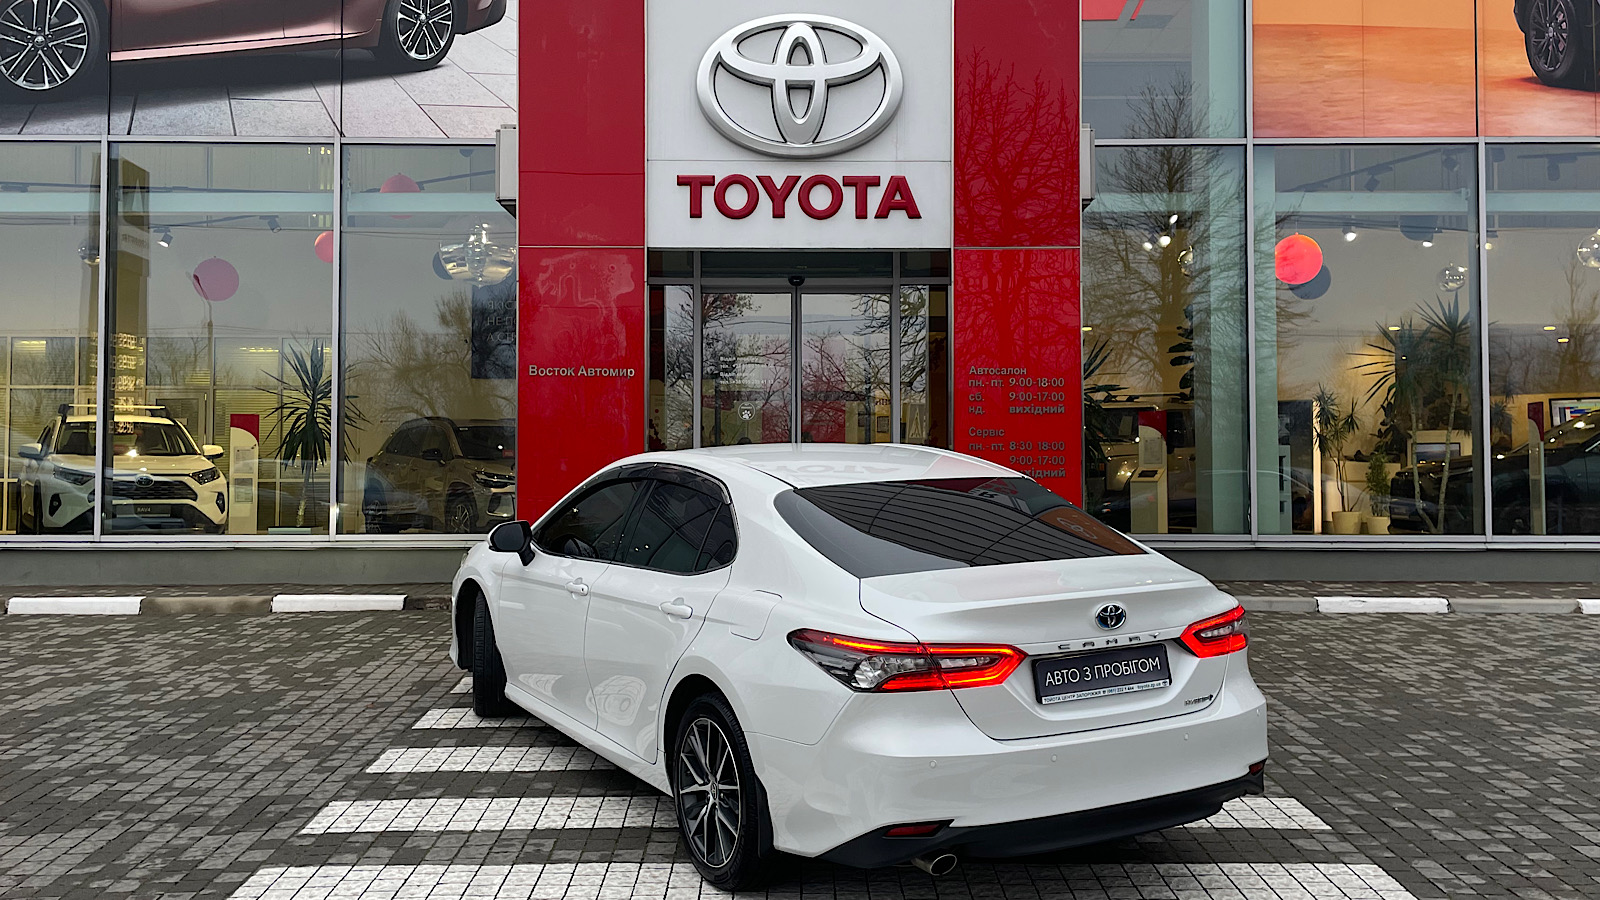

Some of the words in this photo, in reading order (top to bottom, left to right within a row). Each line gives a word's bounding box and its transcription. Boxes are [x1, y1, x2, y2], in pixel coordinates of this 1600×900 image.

[677, 173, 922, 220] TOYOTA
[529, 364, 575, 377] Восток
[577, 365, 635, 379] Автомир
[969, 365, 1027, 375] Автосалон
[968, 392, 985, 401] сб.
[1009, 391, 1065, 401] 9:00-17:00
[968, 405, 986, 415] нд.
[1009, 404, 1065, 416] вихідний
[968, 427, 1005, 438] Сервіс
[1009, 455, 1066, 465] 9:00-17:00
[1058, 632, 1161, 650] CAMRY
[1045, 668, 1080, 687] АВТО
[1094, 656, 1161, 680] ПРОБІГОМ
